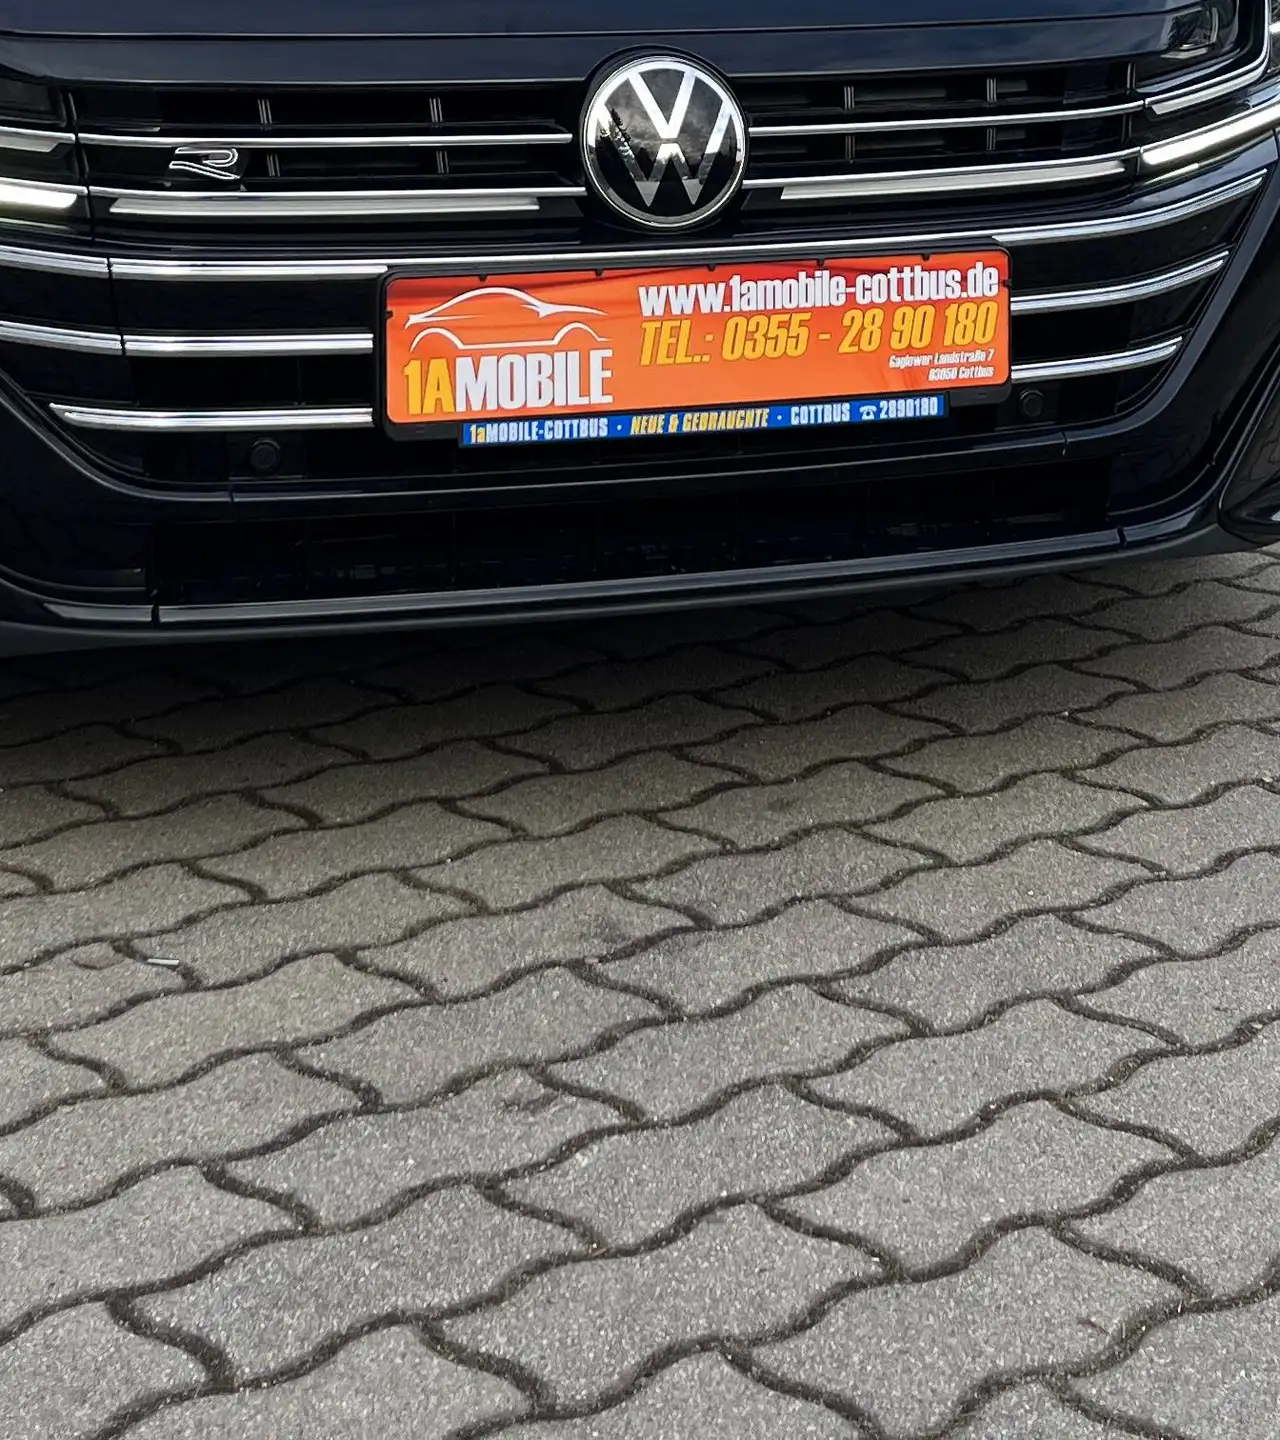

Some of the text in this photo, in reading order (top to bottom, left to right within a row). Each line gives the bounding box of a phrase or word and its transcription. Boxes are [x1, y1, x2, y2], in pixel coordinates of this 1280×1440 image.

[584, 54, 744, 226] VW
[638, 261, 999, 317] www.1amobile-cottbus.de
[640, 319, 715, 366] TEL.:
[722, 312, 812, 361] 0355
[838, 307, 885, 354] 28
[889, 304, 936, 350] 90
[943, 300, 999, 347] 180
[987, 348, 995, 361] 7
[403, 348, 614, 415] 1AMOBILE
[958, 365, 994, 379] Cottbus
[470, 417, 609, 445] 1aMOBILE-COTTBUS
[630, 415, 664, 436] NEUE
[682, 408, 770, 433] GEBRAUCHTE
[790, 402, 851, 426] COTTBUS
[879, 396, 938, 420] 2890180
